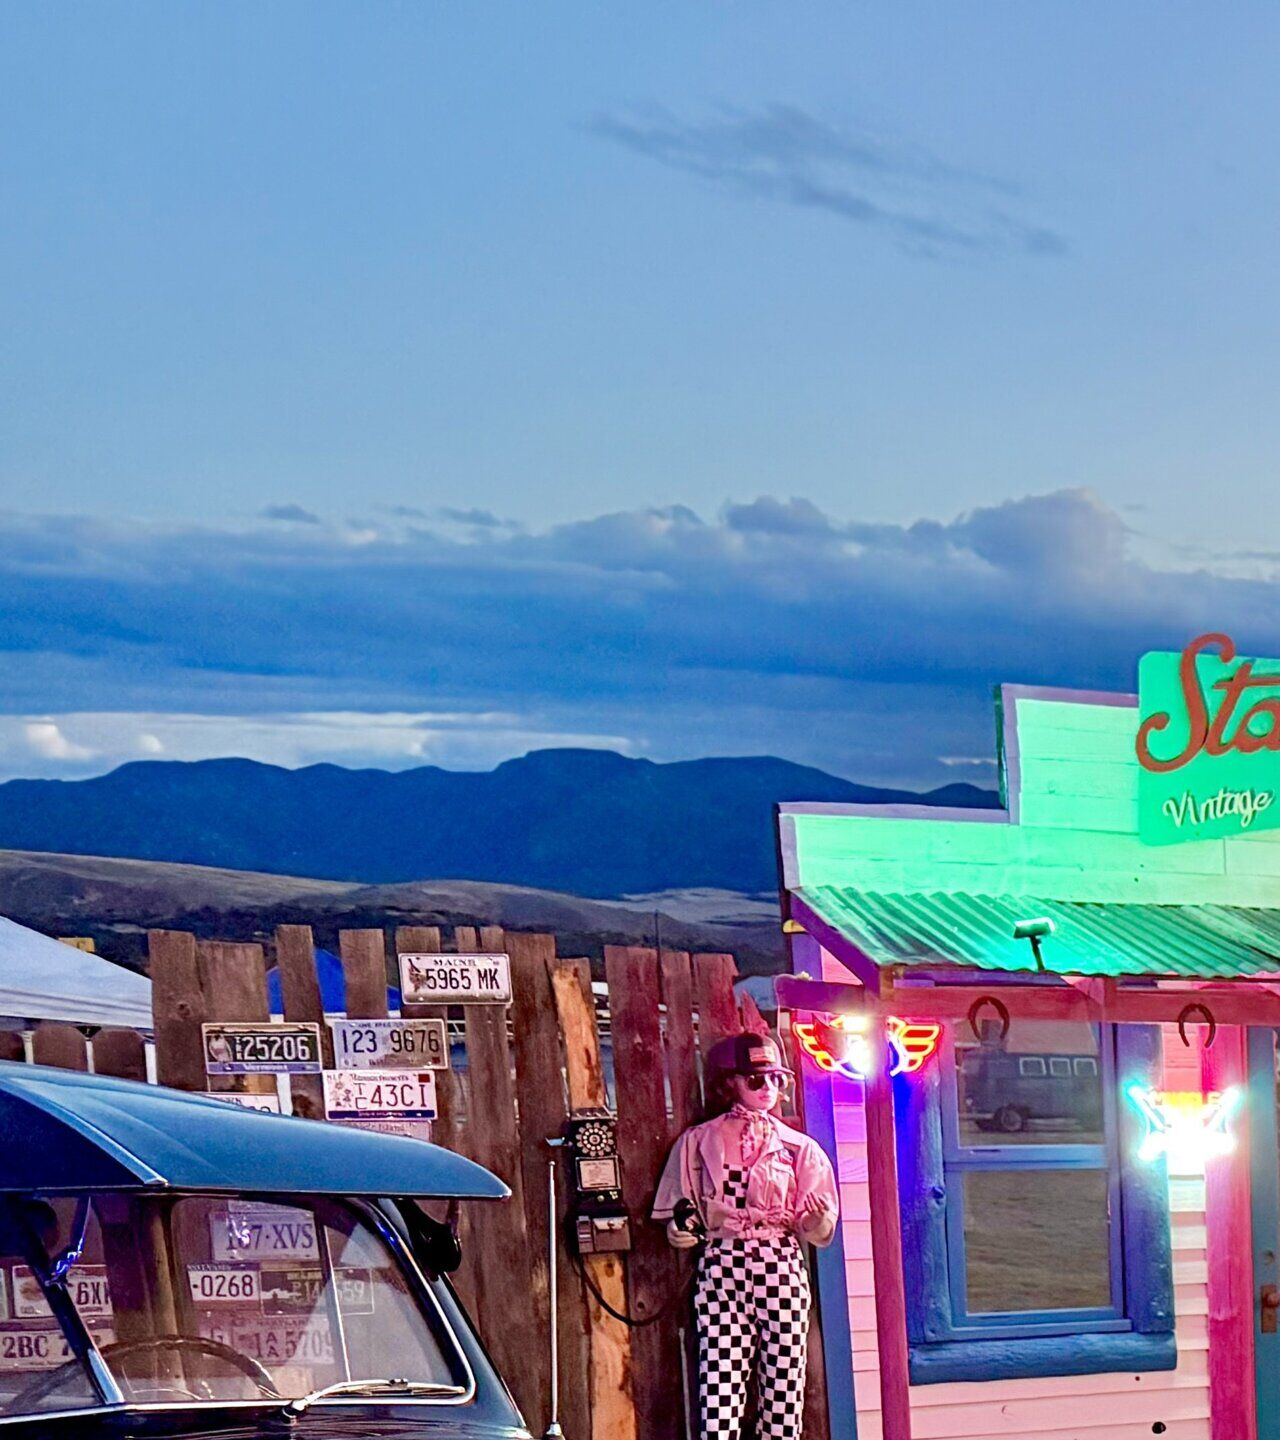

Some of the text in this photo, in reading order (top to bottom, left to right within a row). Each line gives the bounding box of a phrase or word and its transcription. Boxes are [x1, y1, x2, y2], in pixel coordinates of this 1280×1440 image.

[1163, 789, 1274, 828] Vintage
[426, 968, 501, 989] 5965 MK
[244, 1037, 311, 1060] 25206
[342, 1030, 439, 1053] 123 9676
